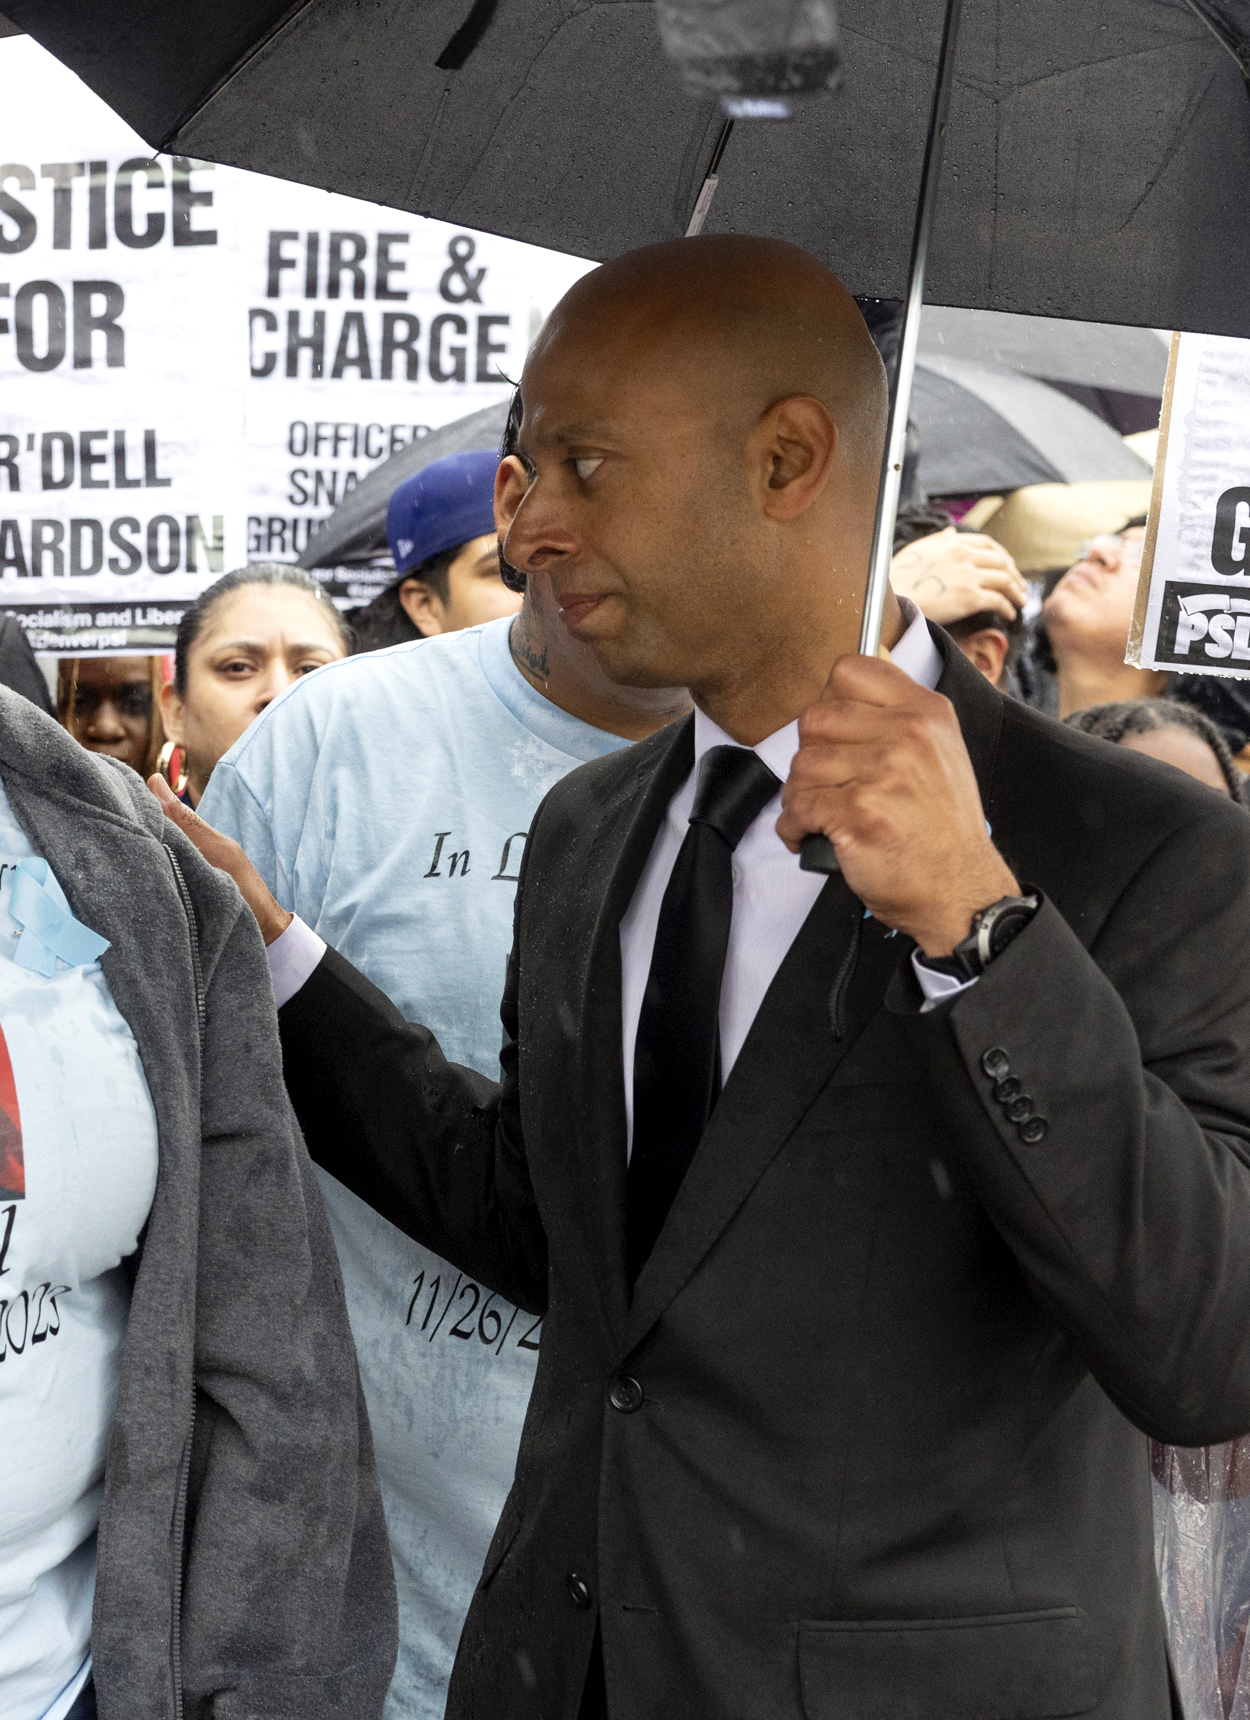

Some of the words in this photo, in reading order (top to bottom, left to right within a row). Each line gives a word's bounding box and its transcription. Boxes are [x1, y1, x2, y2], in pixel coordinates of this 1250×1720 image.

[266, 229, 410, 302] FIRE
[439, 234, 488, 305] &
[248, 307, 511, 384] CHARGE
[247, 516, 325, 553] GRU
[95, 608, 132, 627] and
[423, 831, 471, 879] In
